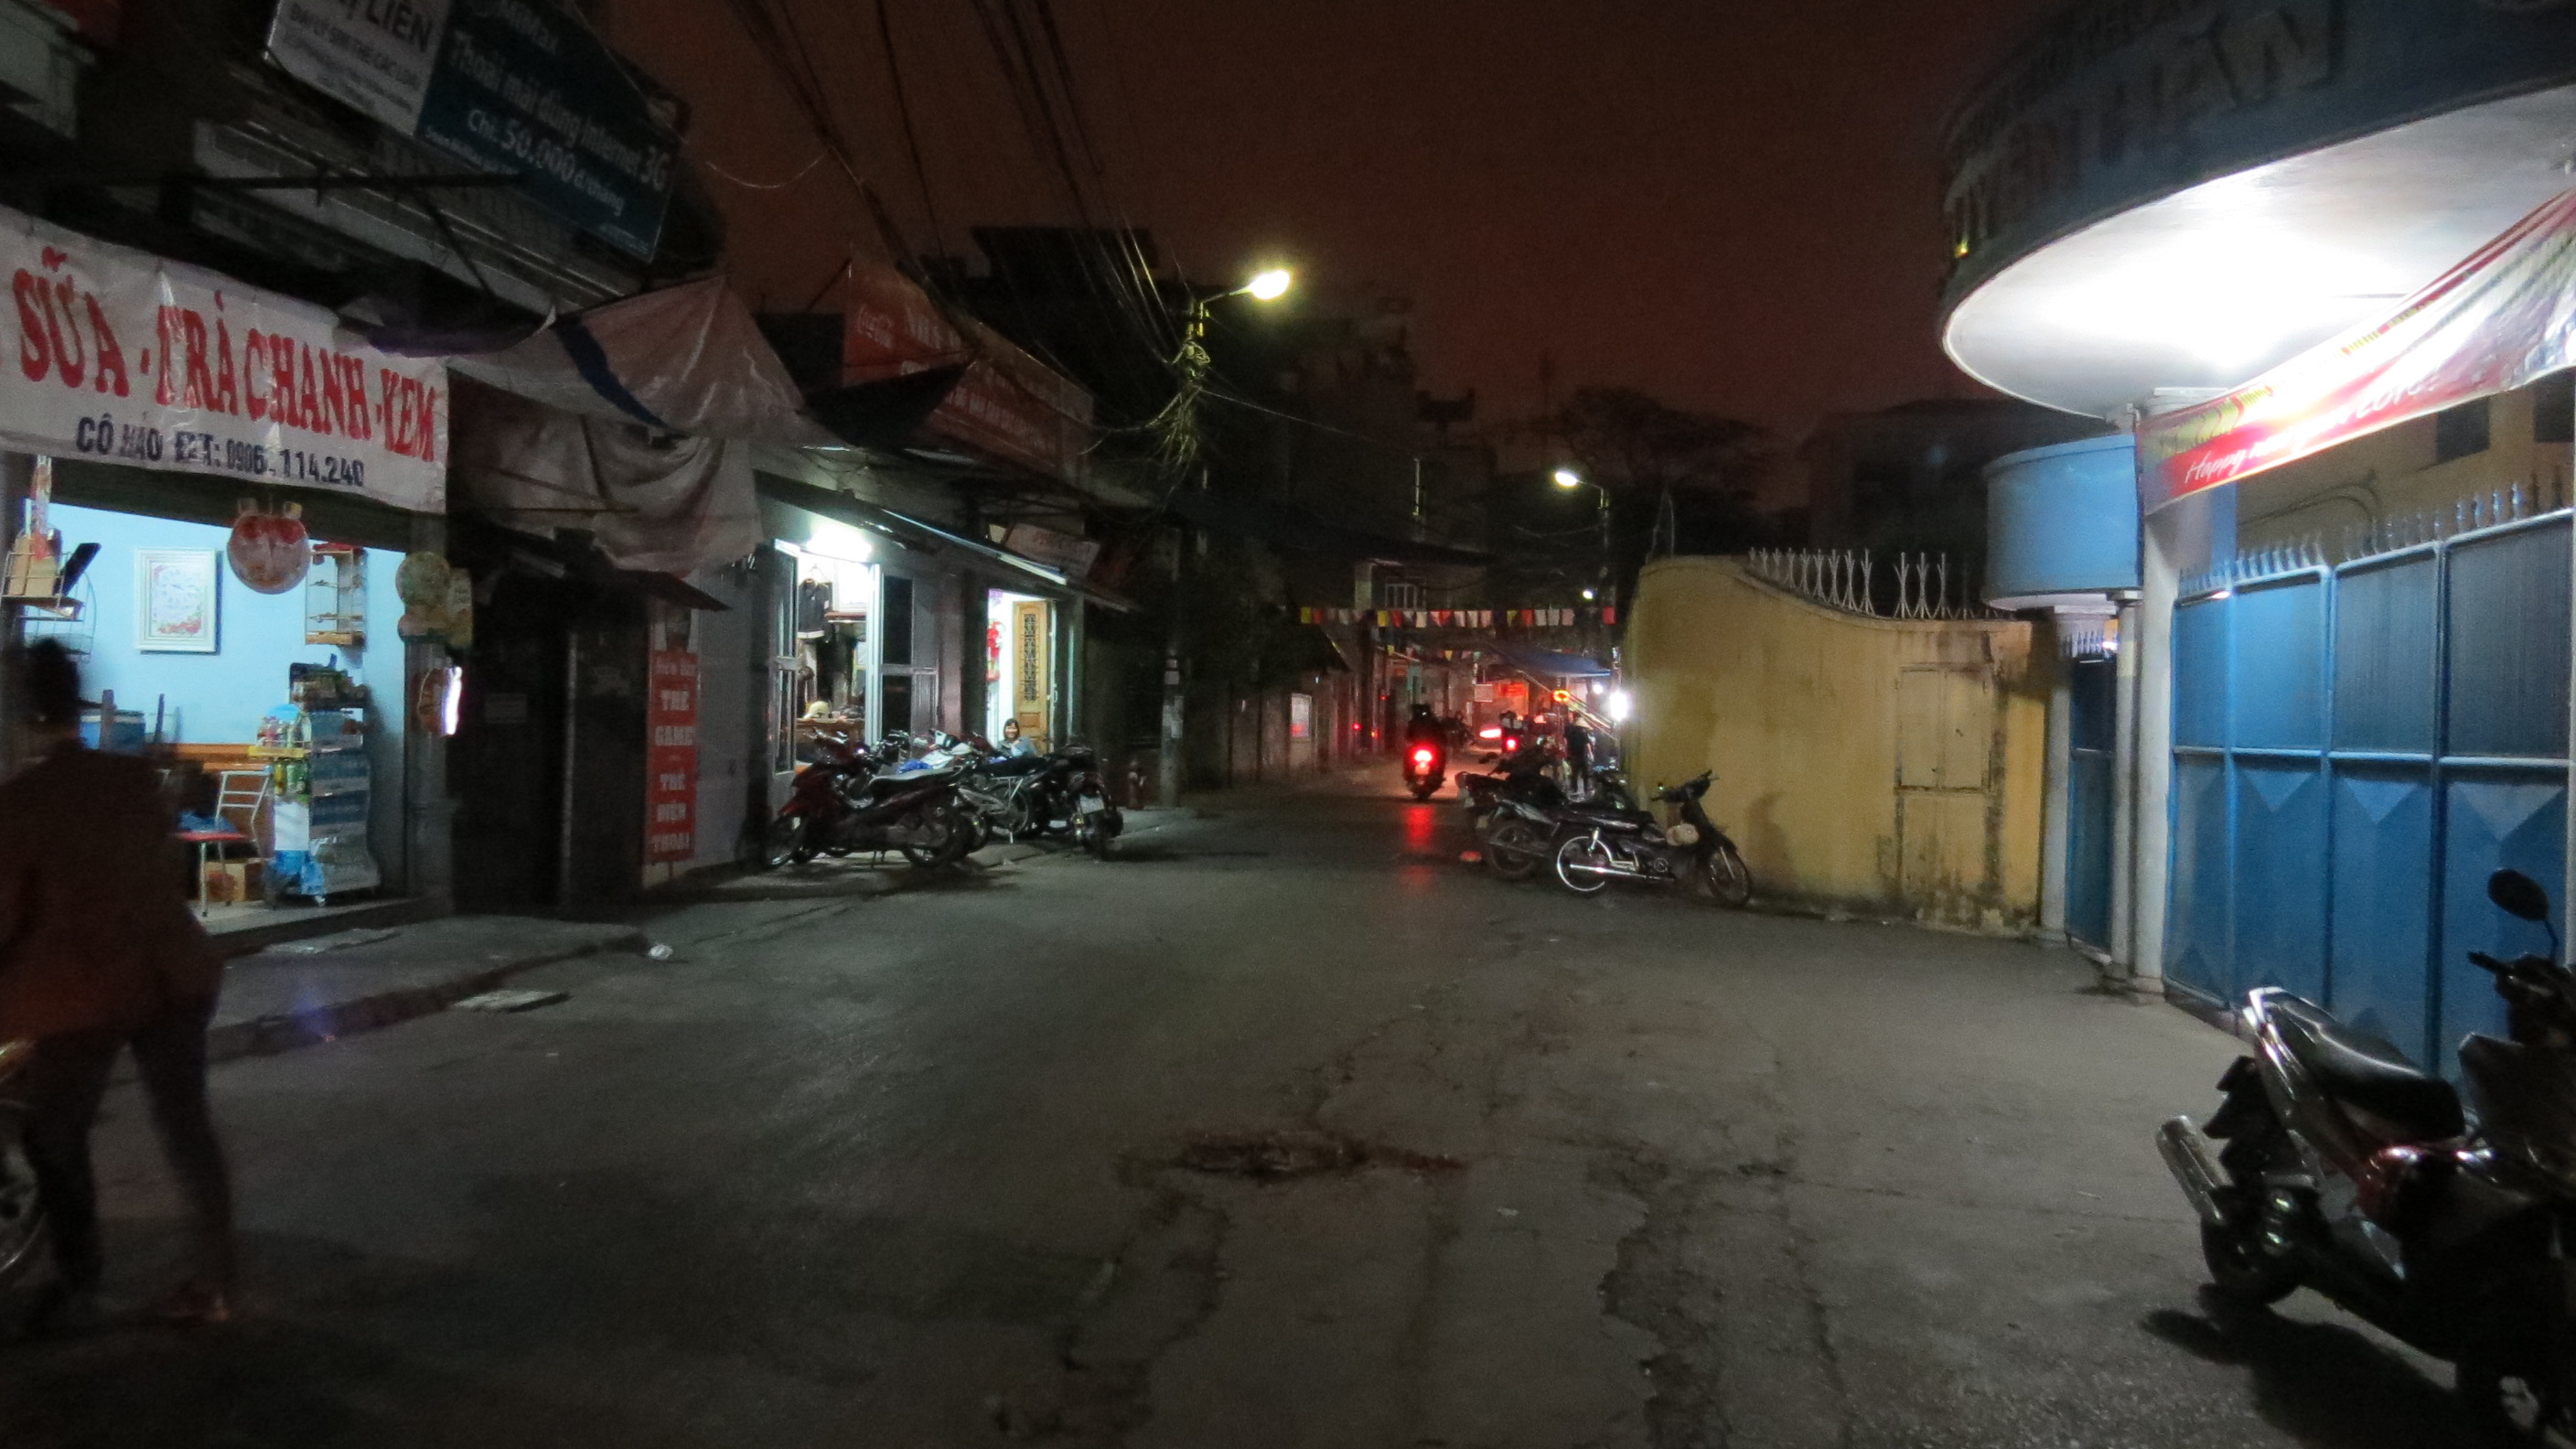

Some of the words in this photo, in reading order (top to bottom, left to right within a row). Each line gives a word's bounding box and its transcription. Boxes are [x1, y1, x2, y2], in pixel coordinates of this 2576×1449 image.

[13, 248, 130, 397] SỮA
[156, 291, 238, 416] TRÀ
[244, 327, 371, 440] CHANH
[77, 413, 114, 455] CÔ
[2184, 449, 2246, 483] Happy
[655, 725, 693, 746] GAME
